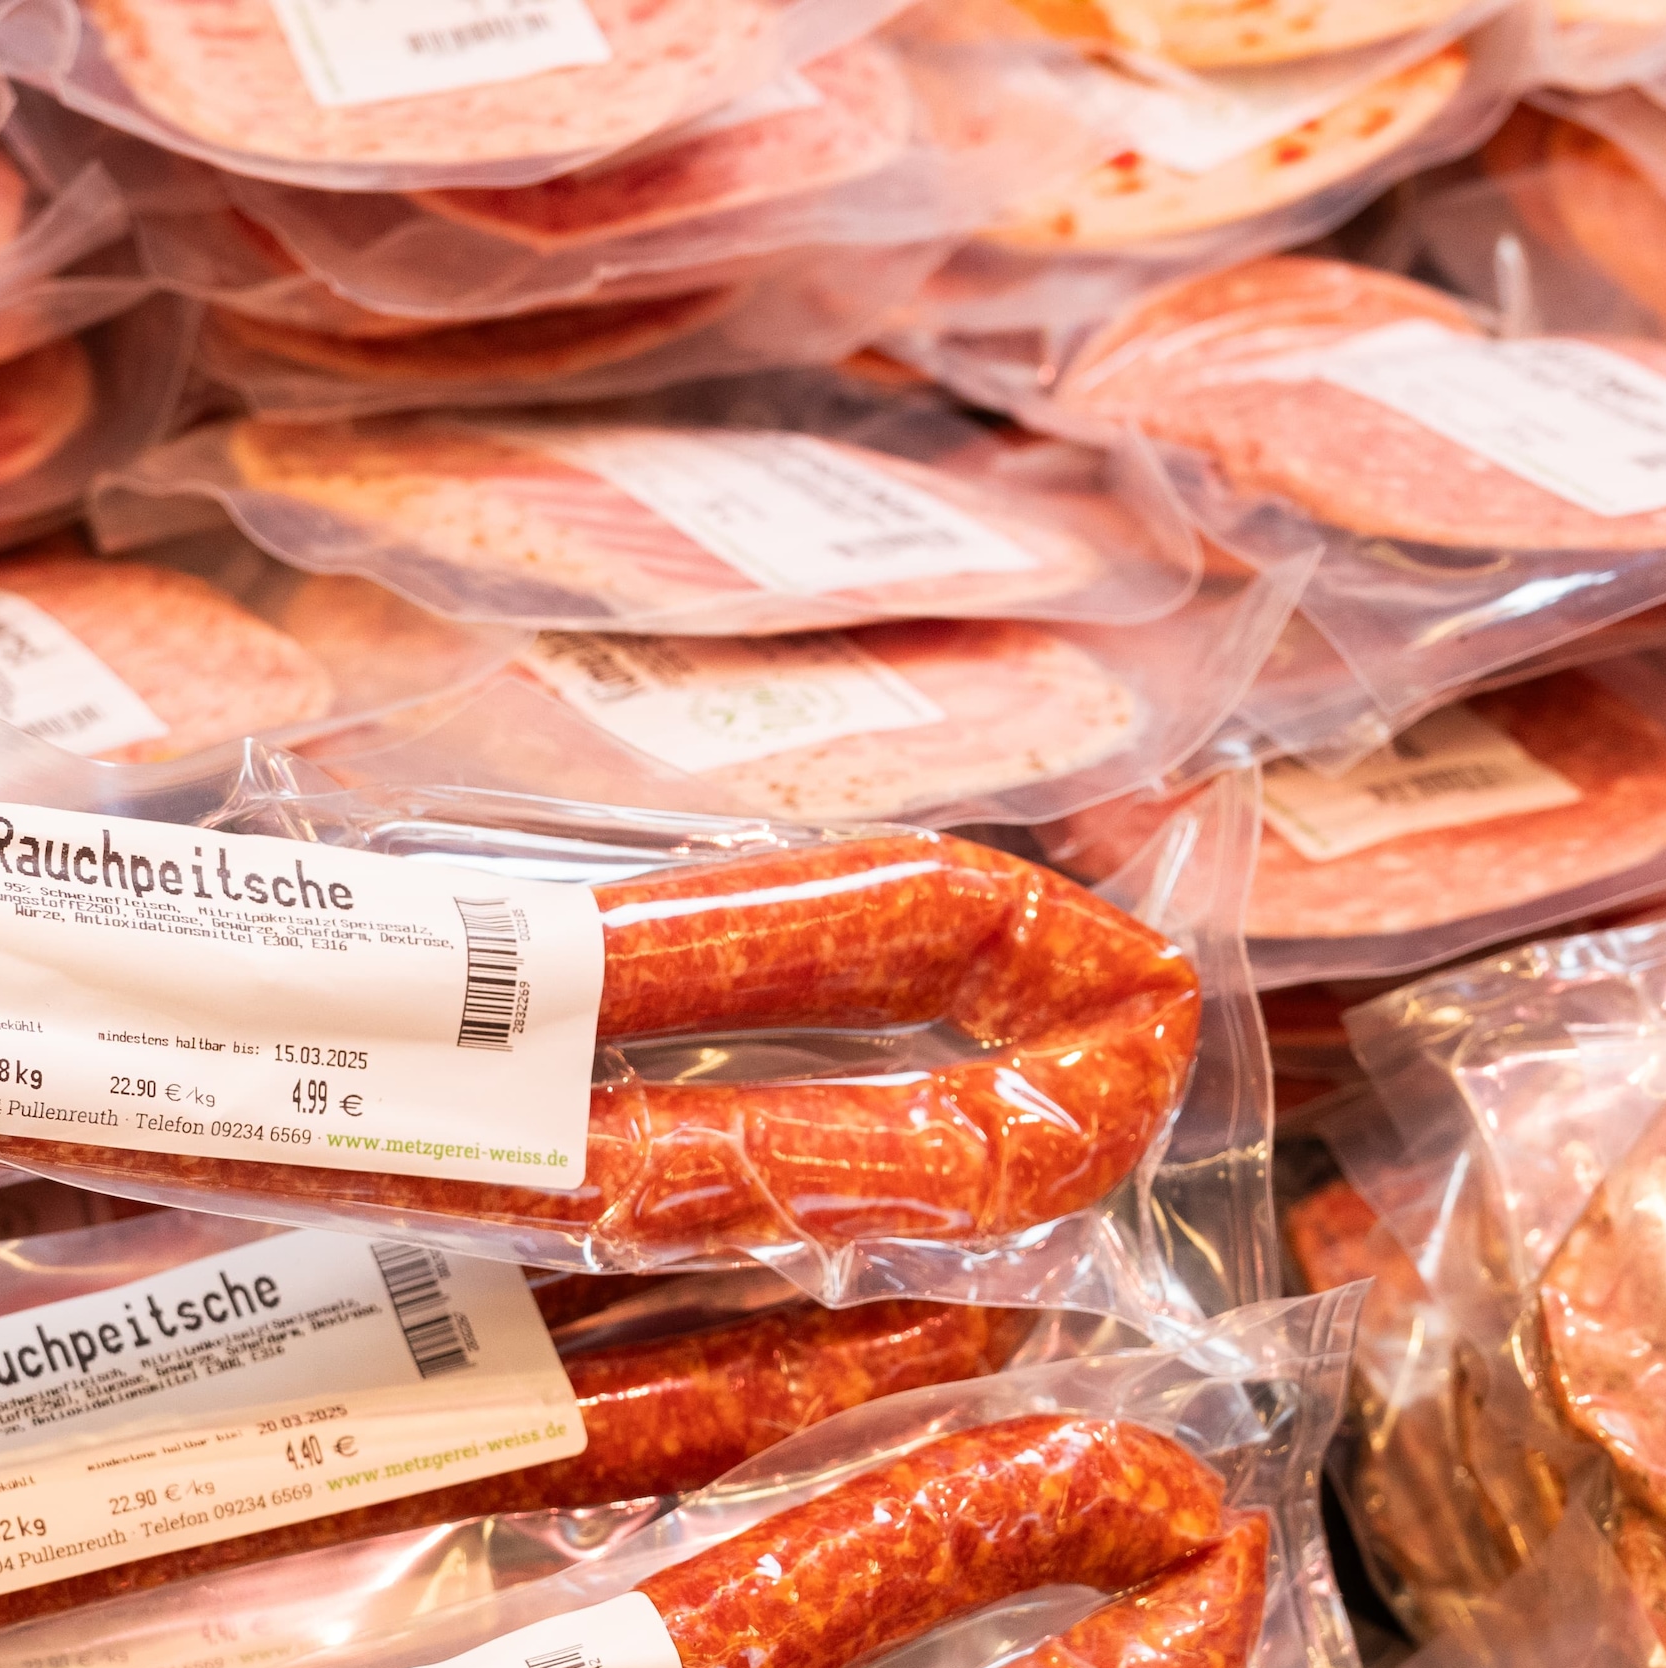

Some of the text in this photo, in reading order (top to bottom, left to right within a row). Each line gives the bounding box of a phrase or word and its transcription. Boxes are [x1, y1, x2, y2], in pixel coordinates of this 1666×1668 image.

[310, 937, 348, 952] E316
[511, 980, 531, 1035] 2832269
[97, 1030, 169, 1047] mindestens
[175, 1035, 227, 1052] haltbar
[232, 1040, 260, 1056] bis:
[274, 1042, 368, 1070] 15.03.2025
[109, 1075, 157, 1099] 22.90
[291, 1078, 328, 1115] 4.99
[338, 1093, 363, 1118] €
[6, 1099, 119, 1127] Pullenreuth
[134, 1112, 205, 1136] Telefon
[210, 1120, 264, 1141] 09234
[269, 1125, 312, 1145] 6569
[325, 1132, 569, 1168] www.metzgerei-weiss.de
[108, 1488, 158, 1516] 22.90
[285, 1434, 324, 1470] 4.40
[17, 1528, 128, 1569] Pullenreuth
[212, 1493, 267, 1520] 09234
[270, 1482, 313, 1506] 6569
